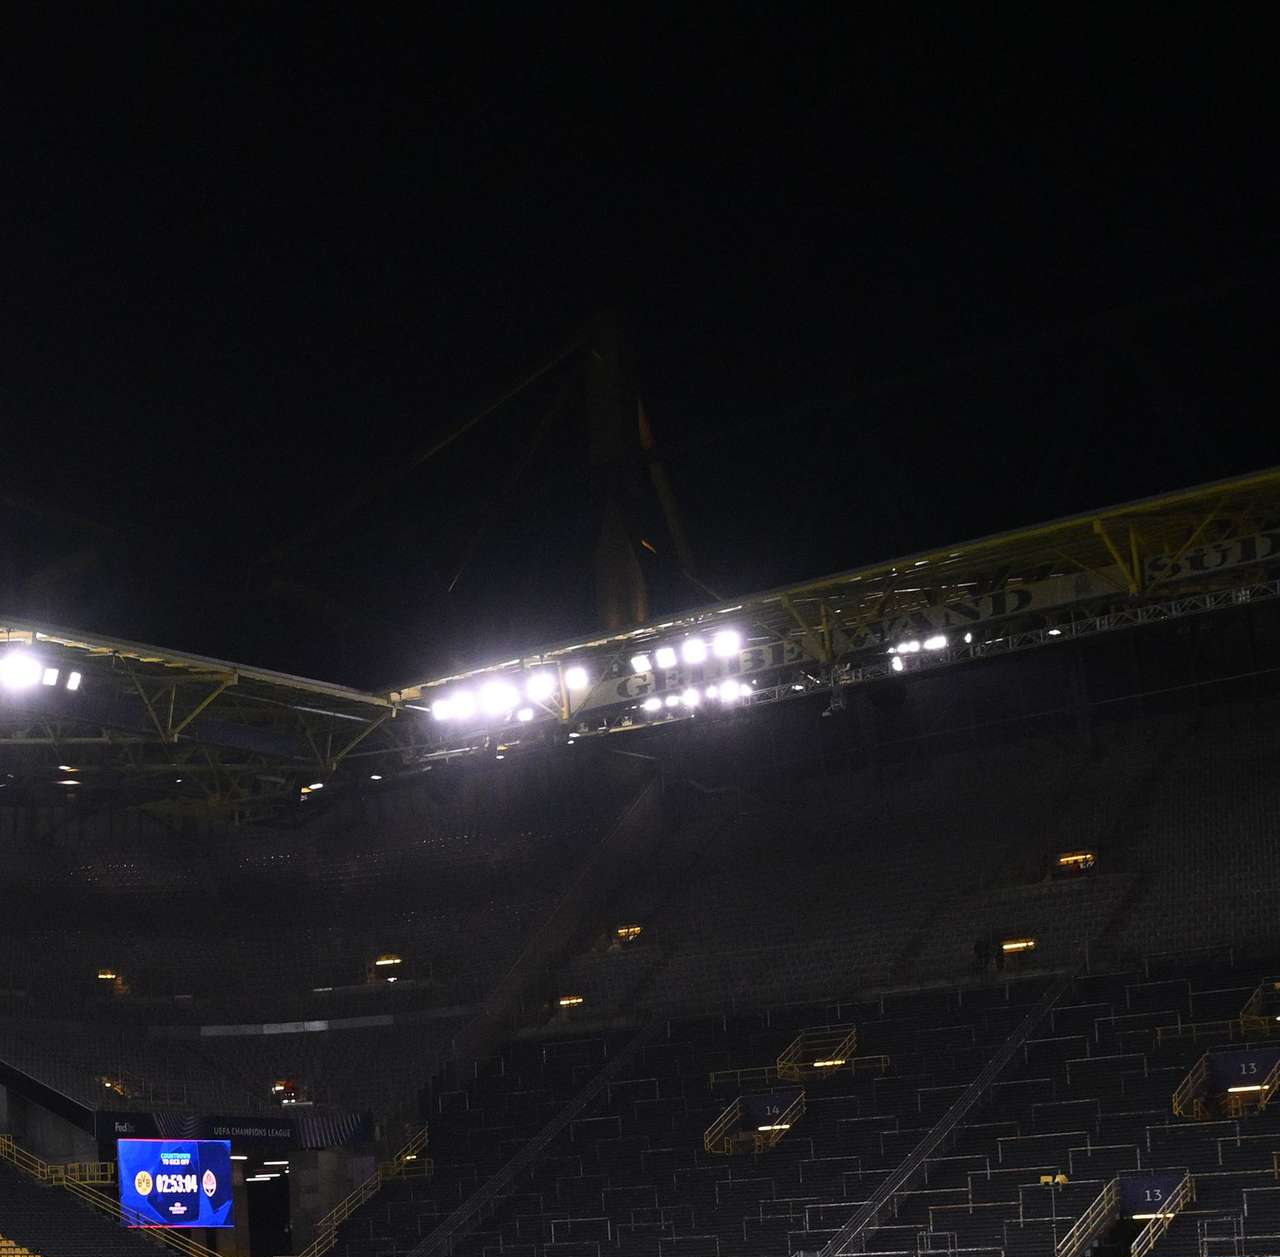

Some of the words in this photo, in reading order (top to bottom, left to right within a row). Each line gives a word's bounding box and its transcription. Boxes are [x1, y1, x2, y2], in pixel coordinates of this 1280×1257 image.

[1240, 1062, 1257, 1075] 13
[766, 1105, 780, 1116] 14
[231, 1127, 267, 1137] CHAMPIONS
[267, 1128, 292, 1138] LEAGUE
[1144, 1189, 1162, 1202] 13
